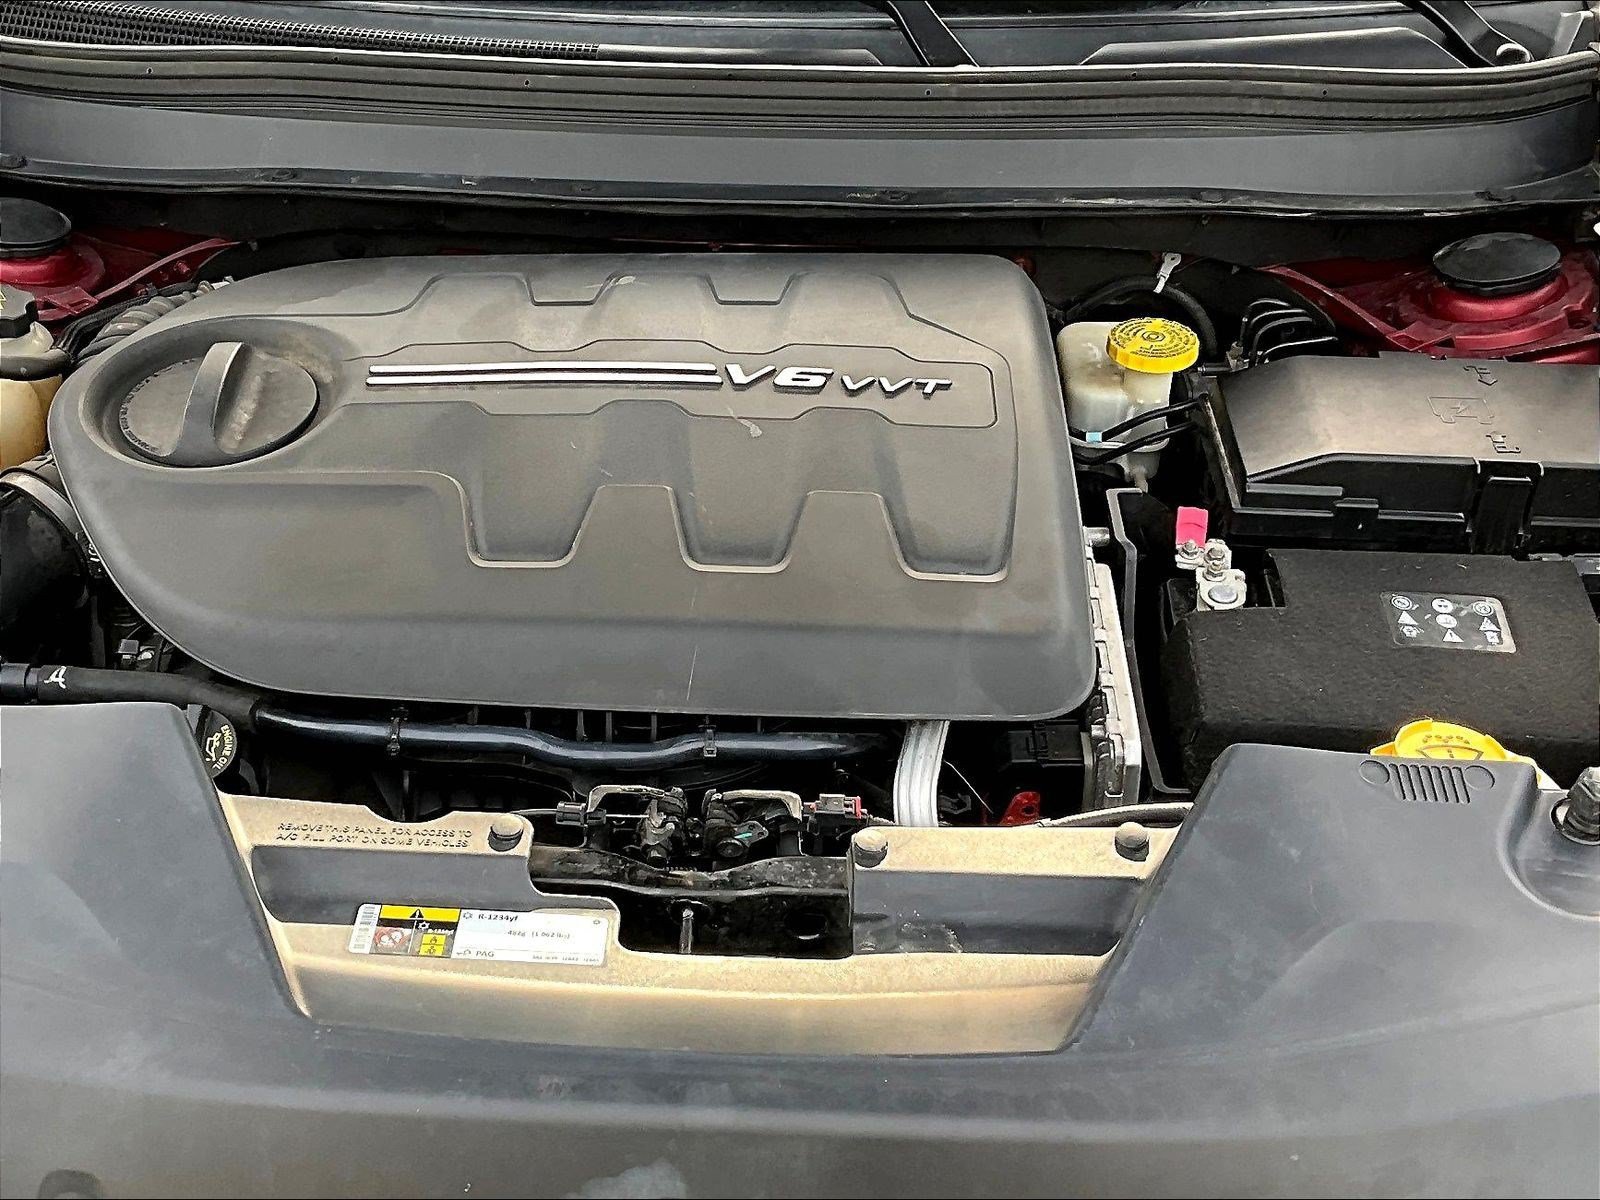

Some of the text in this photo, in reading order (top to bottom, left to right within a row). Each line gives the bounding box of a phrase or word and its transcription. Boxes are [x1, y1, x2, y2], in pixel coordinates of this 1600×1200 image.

[725, 363, 953, 396] V6 VVT
[211, 724, 234, 770] ENGINE OIL
[277, 822, 323, 833] REMOVE
[352, 826, 387, 836] PANEL
[390, 827, 411, 836] FOR
[413, 828, 456, 838] ACCESS
[458, 829, 473, 839] TO
[276, 832, 469, 848] A/C FILL PORT ON SOME VEHICLES
[477, 912, 519, 923] R-1234yf
[475, 950, 495, 958] PAG
